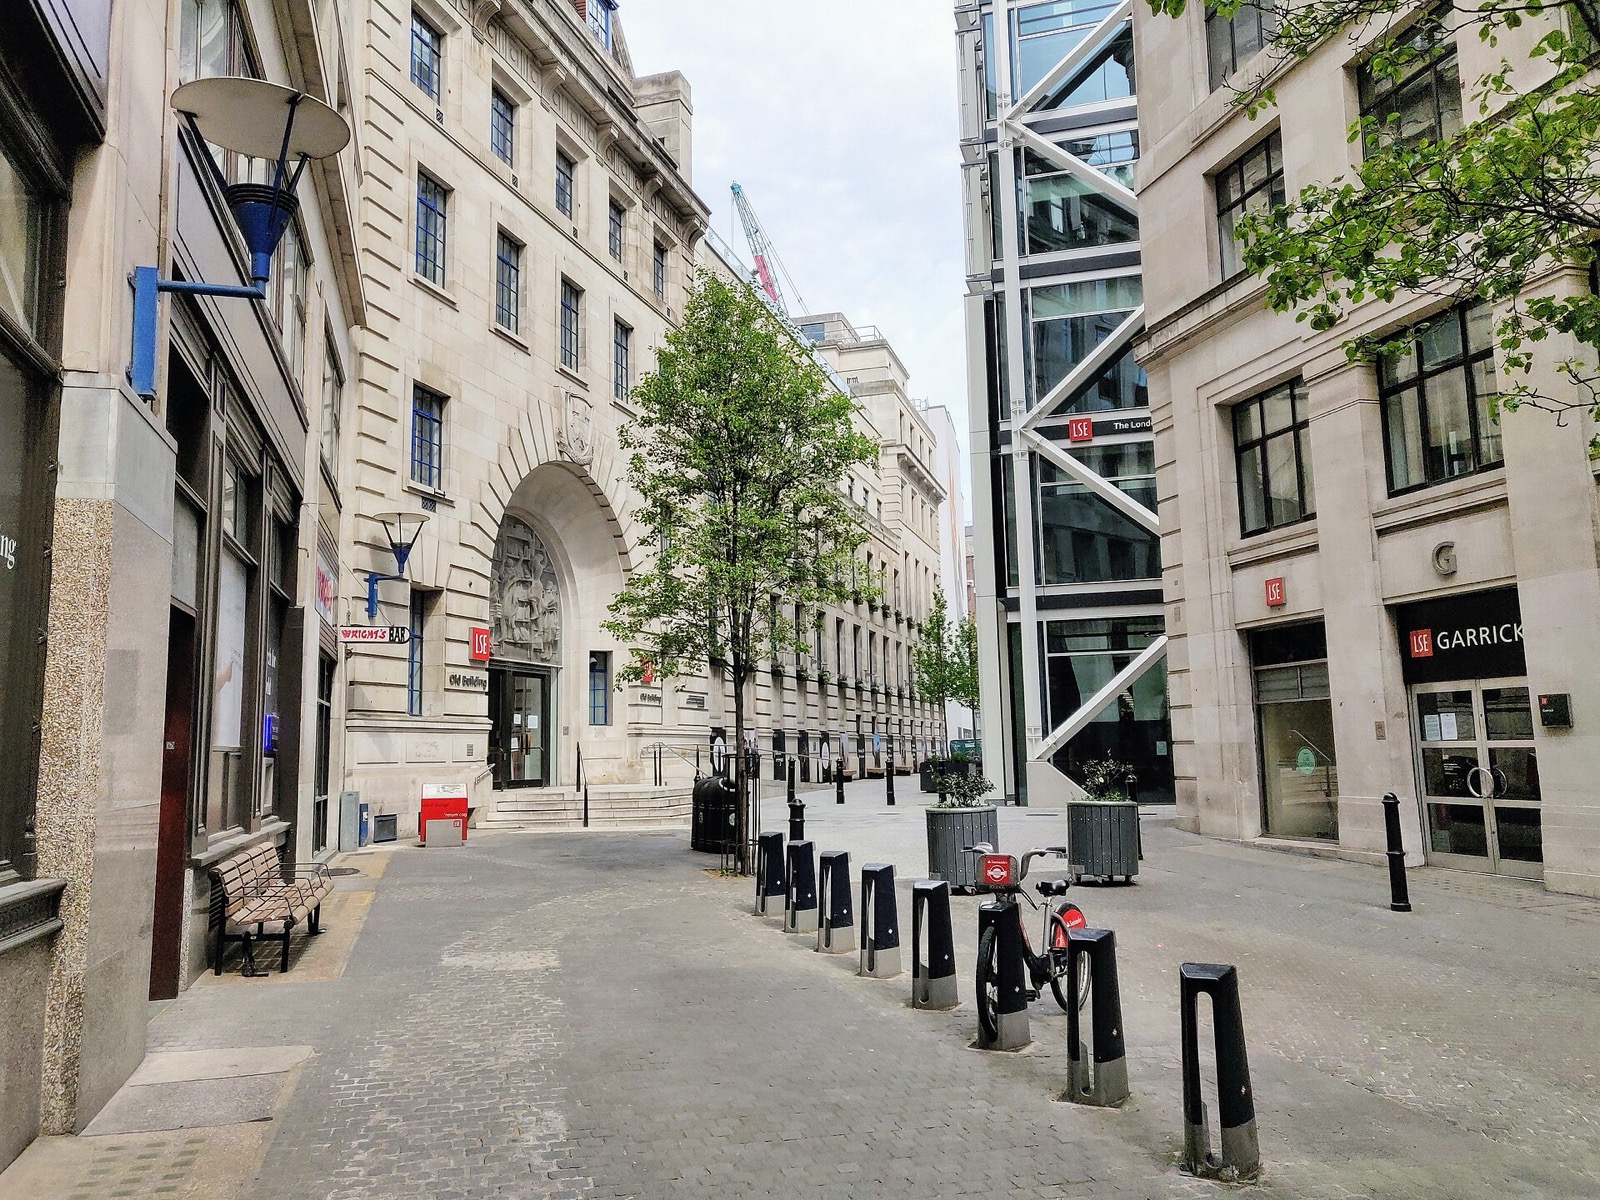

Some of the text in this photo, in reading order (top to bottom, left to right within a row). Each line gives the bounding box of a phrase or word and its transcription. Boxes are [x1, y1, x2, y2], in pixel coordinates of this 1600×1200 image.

[1072, 422, 1088, 437] LSE
[1114, 422, 1129, 430] The
[1431, 540, 1458, 575] G
[1268, 583, 1281, 601] LSE
[341, 627, 406, 644] WRIGHT'S BAR
[475, 633, 488, 655] LSE
[1413, 623, 1524, 653] LSE GARRICK
[449, 673, 487, 691] Old Building
